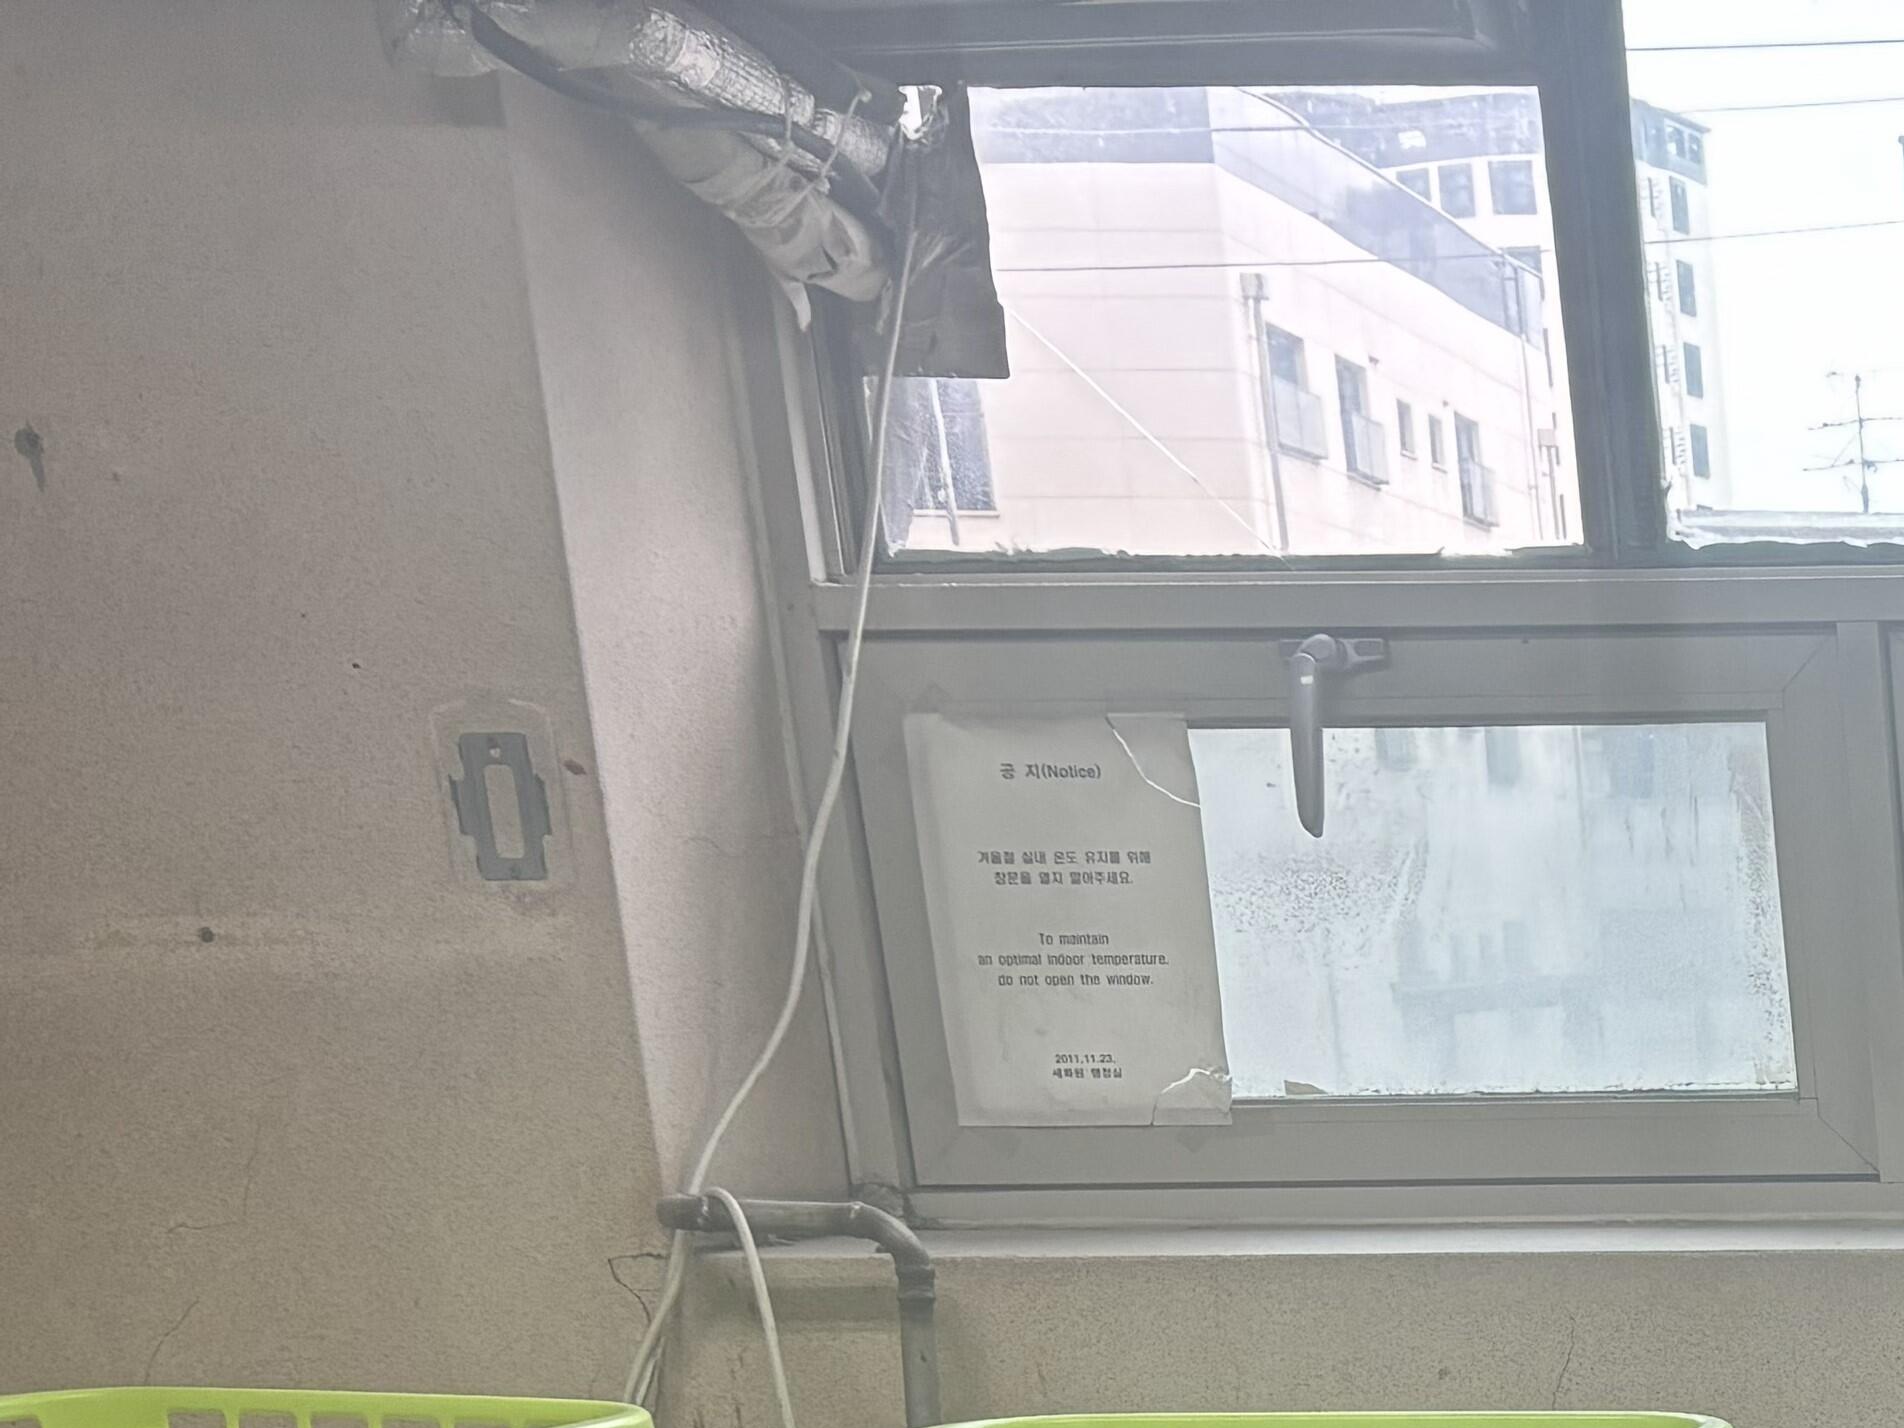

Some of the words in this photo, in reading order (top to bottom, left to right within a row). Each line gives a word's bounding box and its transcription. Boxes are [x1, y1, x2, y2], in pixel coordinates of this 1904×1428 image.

[1038, 932, 1054, 946] To
[1058, 933, 1109, 946] maintain
[977, 954, 993, 966] an
[998, 953, 1042, 967] optimal
[1047, 953, 1085, 966] indoor
[997, 974, 1014, 987] do
[1019, 974, 1040, 986] not
[1044, 974, 1075, 987] open
[1079, 973, 1101, 986] the
[1105, 973, 1154, 986] window.
